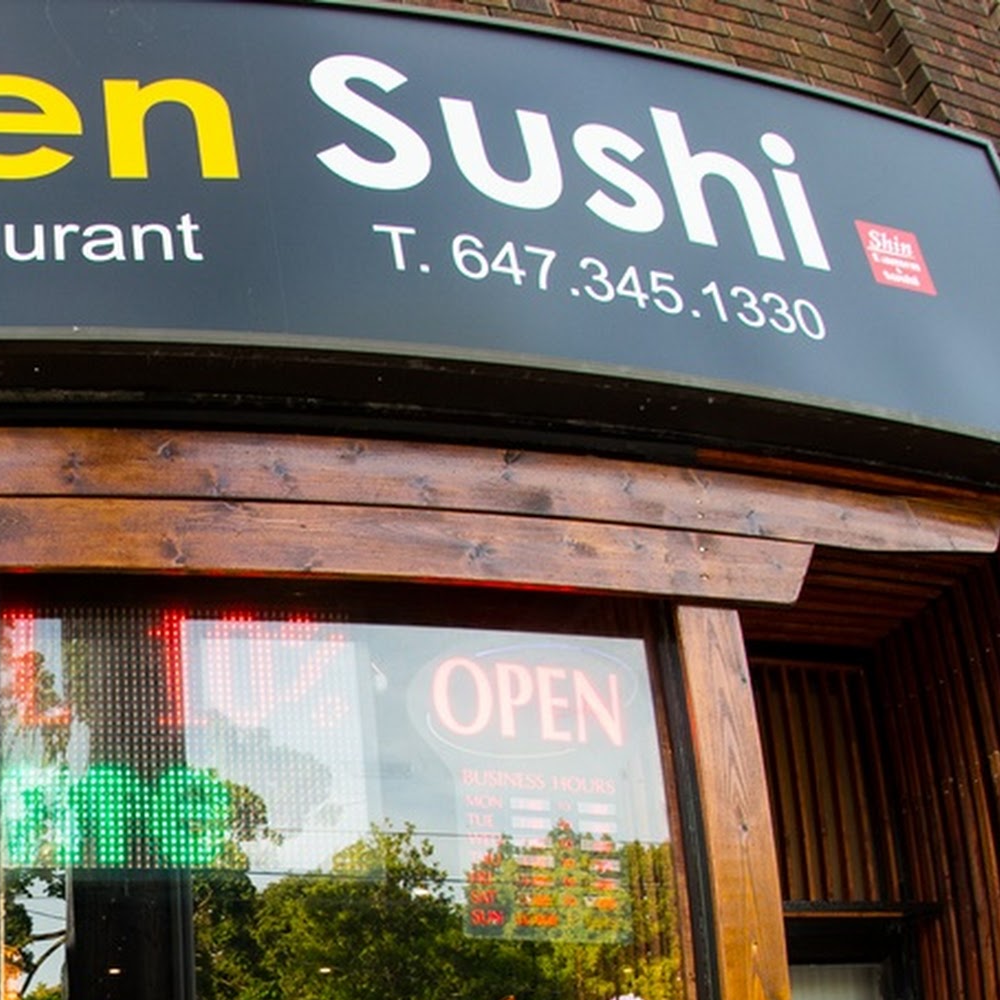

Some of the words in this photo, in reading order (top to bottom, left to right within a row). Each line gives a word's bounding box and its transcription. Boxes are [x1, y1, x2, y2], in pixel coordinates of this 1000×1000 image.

[309, 54, 831, 271] Sushi
[372, 223, 431, 274] T.
[451, 233, 827, 341] 647.345.1330
[866, 228, 913, 257] Shin
[432, 656, 624, 747] OPEN
[461, 768, 546, 789] BUSINESS
[551, 775, 616, 795] HOURS
